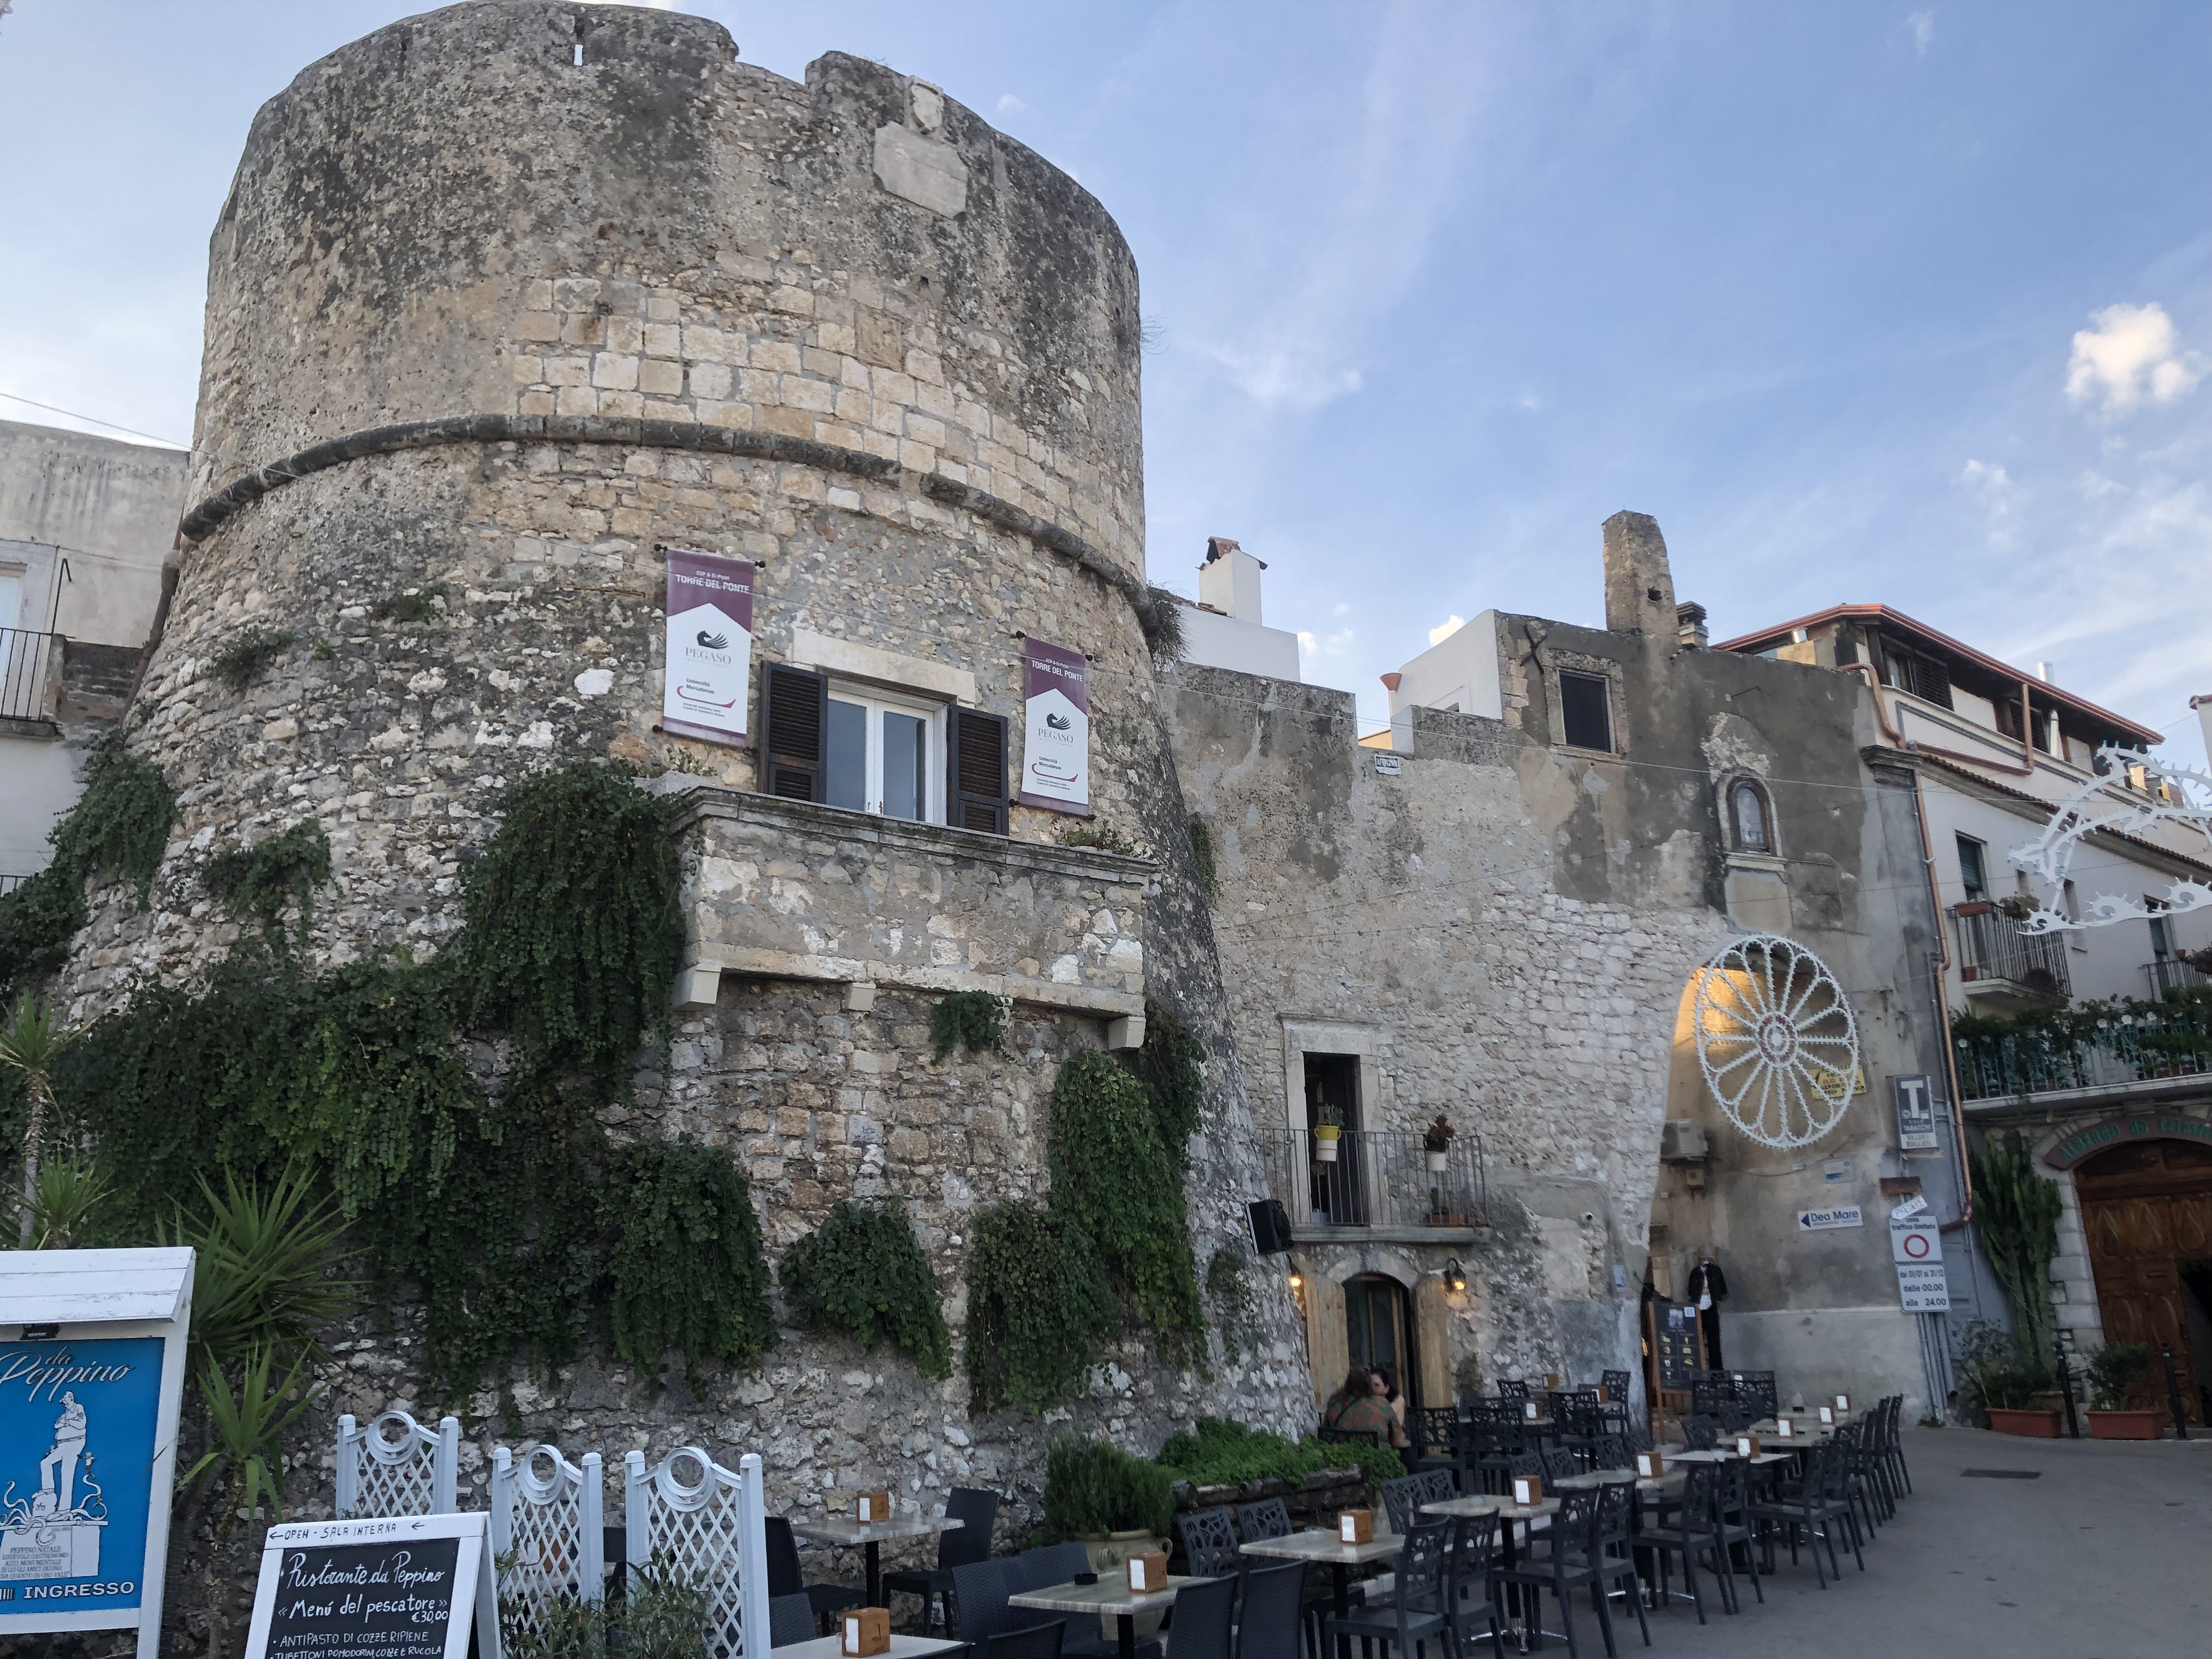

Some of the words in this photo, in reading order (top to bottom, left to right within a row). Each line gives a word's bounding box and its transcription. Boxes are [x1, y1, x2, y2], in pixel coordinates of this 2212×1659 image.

[676, 573, 704, 586] TORRE
[705, 579, 721, 589] DEL
[723, 581, 749, 593] PONTE
[685, 647, 732, 664] PEGASO
[1031, 660, 1051, 672] TORRE
[1052, 666, 1063, 676] DEL
[1064, 670, 1083, 682] PONTE
[686, 678, 710, 687] Università
[1038, 728, 1073, 743] PEGASO
[1901, 1080, 1923, 1118] T
[2058, 1123, 2120, 1161] ALBERGO
[2128, 1119, 2150, 1135] da
[1811, 1213, 1830, 1222] Dea
[1833, 1211, 1859, 1219] Mare
[45, 1346, 72, 1365] da
[0, 1350, 136, 1403] Peppino
[284, 1529, 309, 1540] OPEN
[320, 1526, 348, 1539] SALA
[353, 1522, 397, 1536] INTERNA
[287, 1552, 368, 1589] Ristorante
[368, 1559, 390, 1584] da
[392, 1550, 445, 1589] Peppino
[24, 1581, 134, 1599] INGRESSO
[340, 1593, 363, 1615] del
[411, 1610, 449, 1624] €30,00
[279, 1632, 339, 1647] ANTIPASTO
[343, 1632, 353, 1643] DI
[357, 1632, 388, 1644] COZZE
[390, 1631, 429, 1643] RIPIENE
[408, 1646, 442, 1656] RUCOLA
